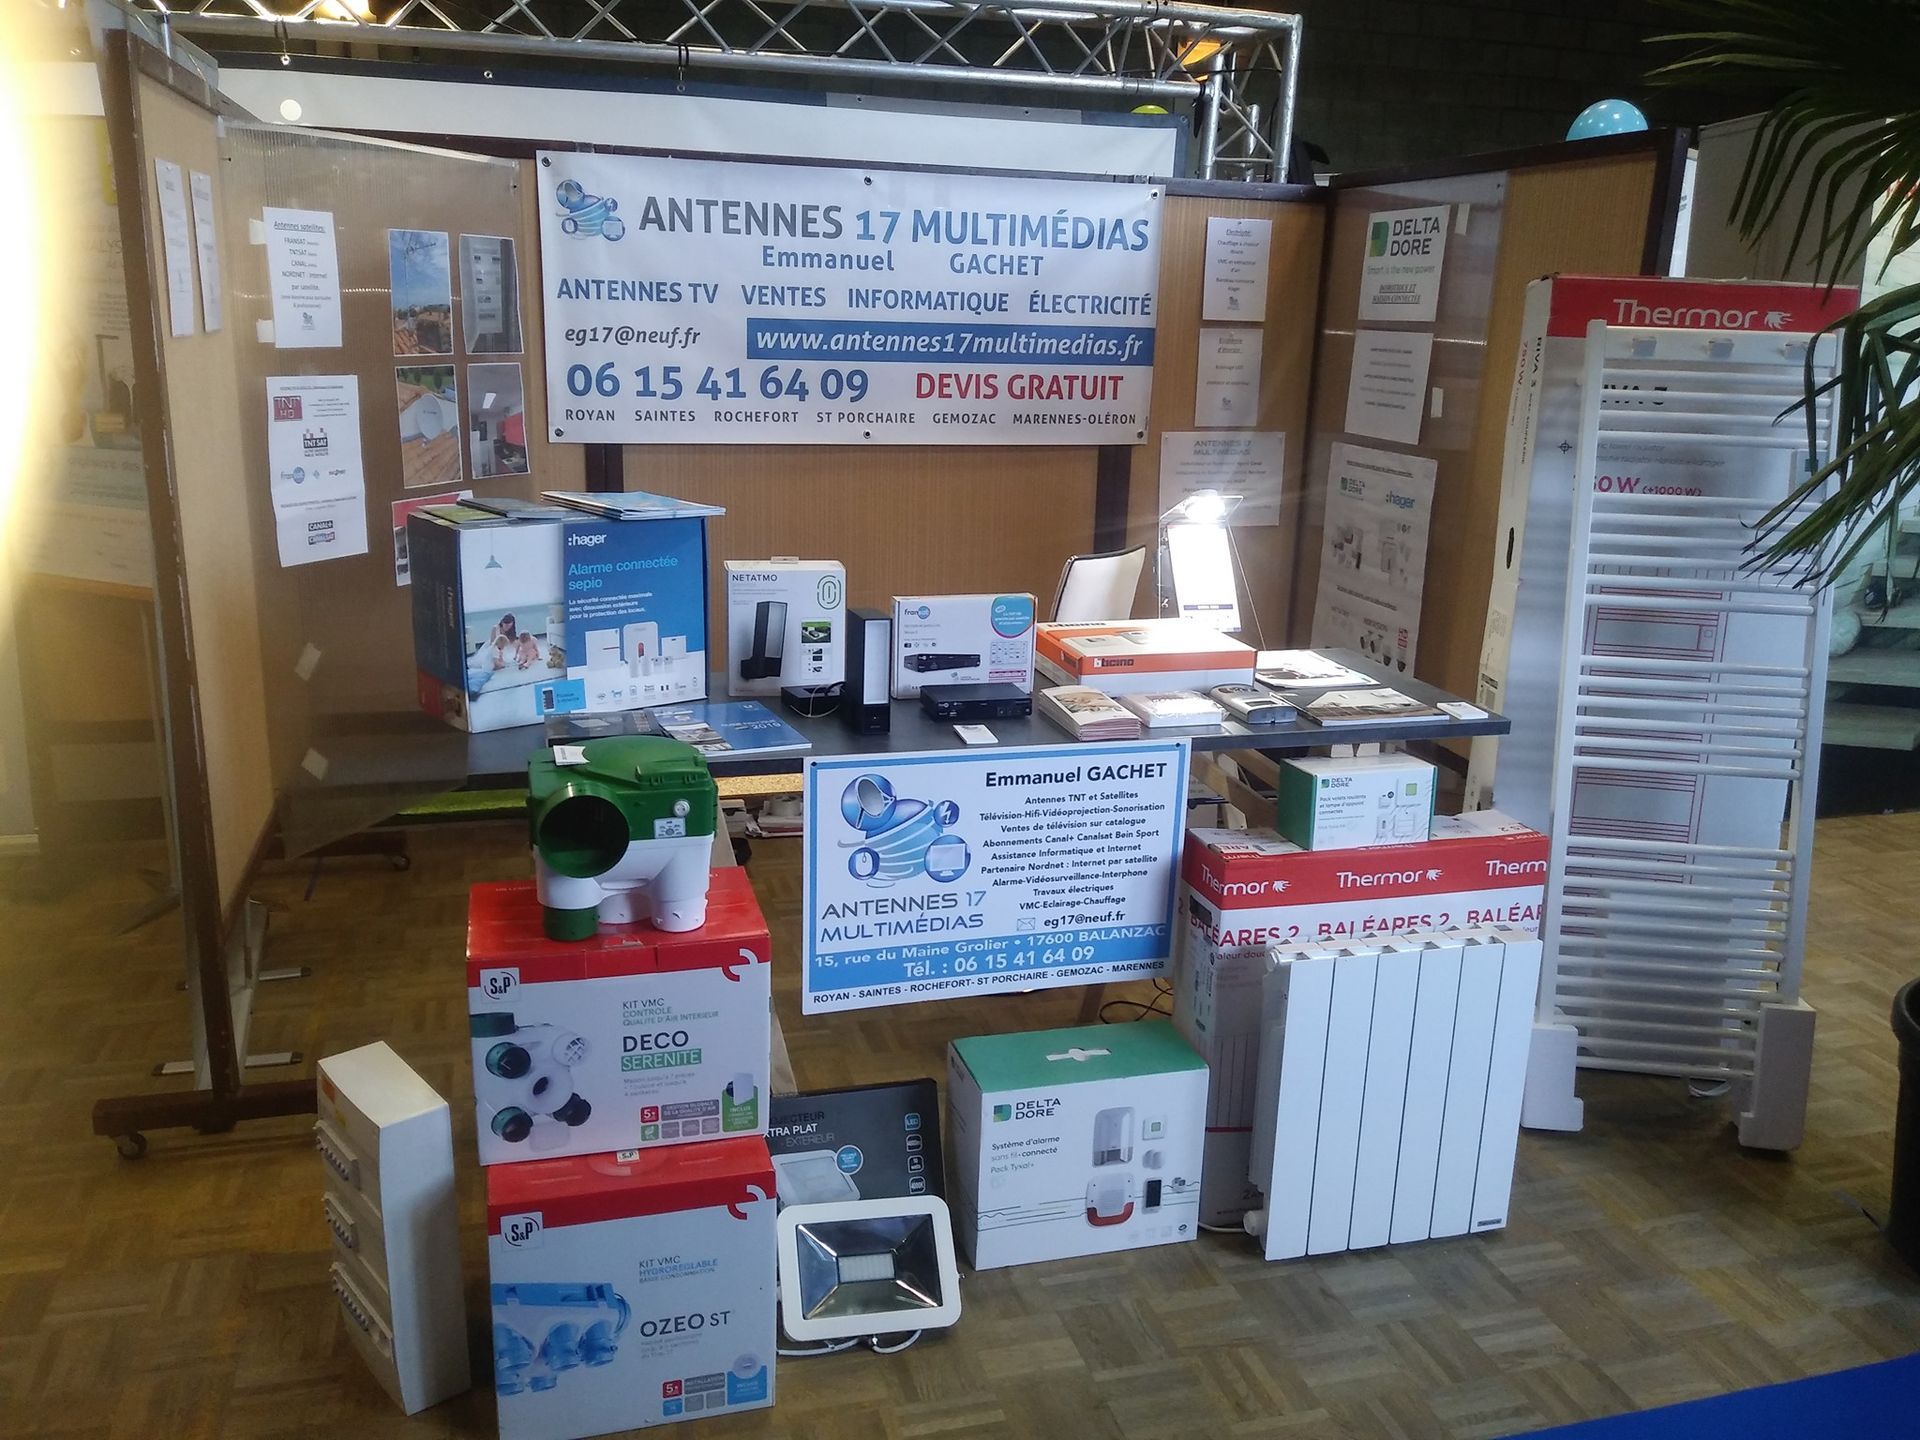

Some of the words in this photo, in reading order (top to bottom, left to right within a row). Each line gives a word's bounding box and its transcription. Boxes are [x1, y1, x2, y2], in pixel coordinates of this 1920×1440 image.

[639, 196, 843, 239] ANTENNES
[856, 209, 901, 244] 17
[911, 208, 1150, 251] MULTIMÉDIAS
[1392, 217, 1440, 236] DELTA
[1390, 238, 1432, 256] DORE
[762, 245, 895, 271] Emmanuel
[950, 252, 1044, 276] GACHET
[557, 278, 682, 303] ANTENNES
[688, 283, 719, 303] TV
[741, 284, 827, 307] VENTES
[848, 288, 1010, 316] INFORMATIQUE
[1029, 289, 1152, 315] ÉLECTRICITÉ
[1613, 299, 1757, 328] Thermor
[564, 326, 701, 348] eg17@neuf.fr
[757, 331, 1143, 361] www.antennes17multimedias.fr
[566, 361, 621, 398] 06
[634, 365, 683, 401] 15
[696, 366, 746, 401] 41
[759, 365, 809, 402] 64
[820, 368, 868, 403] 09
[916, 372, 998, 399] DEVIS
[1007, 374, 1123, 400] GRATUIT
[565, 409, 615, 422] ROYAN
[634, 410, 696, 422] SAINTES
[714, 411, 799, 423] ROCHEFORT
[816, 411, 832, 423] ST
[837, 412, 916, 424] PORCHAIRE
[932, 412, 996, 425] GEMOZAC
[1012, 412, 1136, 426] MARENNES-OLÉRON
[568, 563, 613, 576] Alarme
[616, 556, 679, 572] connectée
[568, 578, 602, 591] sepio
[732, 574, 778, 582] NETATMO
[985, 767, 1081, 787] Emmanuel
[1087, 763, 1167, 782] GACHET
[1024, 795, 1065, 805] Antennes
[1068, 794, 1086, 802] TNT
[1088, 793, 1098, 801] et
[1099, 791, 1139, 801] Satellites
[979, 803, 1165, 821] Télévision-Hifi-Vidéoprojection-Sonorisation
[1000, 824, 1030, 833] Ventes
[1032, 823, 1044, 831] de
[1046, 820, 1087, 830] télévision
[1105, 817, 1146, 828] catalogue
[983, 838, 1043, 848] Abonnements
[1045, 835, 1075, 844] Canal+
[1077, 832, 1113, 841] Canalsat
[1115, 830, 1133, 839] Bein
[1135, 829, 1160, 840] Sport
[991, 851, 1036, 860] Assistance
[1038, 846, 1094, 858] Informatique
[1107, 843, 1142, 852] Internet
[981, 865, 1026, 874] Partenaire
[1028, 861, 1064, 871] Nordnet
[1071, 858, 1106, 867] Internet
[1108, 858, 1123, 866] par
[1124, 855, 1158, 864] satellite
[1486, 860, 1547, 876] Therm
[992, 869, 1148, 887] Alarme-Vidéosurveillance-Interphone
[1202, 864, 1270, 896] Thermor
[1336, 871, 1424, 889] Thermor
[1033, 887, 1065, 896] Travaux
[1068, 883, 1114, 895] électriques
[821, 893, 958, 920] ANTENNES
[965, 891, 987, 907] 17
[1019, 895, 1126, 910] VMC-Eclairage-Chauffage
[820, 912, 984, 942] MULTIMÉDIAS
[1043, 911, 1126, 929] eg17@neuf.fr
[815, 955, 839, 968] 15,
[844, 953, 871, 965] rue
[876, 950, 896, 961] du
[902, 946, 950, 958] Maine
[955, 939, 1009, 954] Grolier
[1027, 933, 1074, 946] 17600
[1078, 925, 1166, 942] BALANZAC
[903, 962, 936, 978] Tél.
[954, 957, 978, 973] 06
[985, 953, 1008, 969] 15
[1012, 950, 1035, 966] 41
[1042, 947, 1065, 964] 64
[1071, 945, 1095, 961] 09
[490, 976, 511, 994] S&P
[813, 992, 850, 1004] ROYAN
[858, 986, 901, 998] SAINTES
[977, 977, 989, 987] ST
[991, 972, 1048, 984] PORCHAIRE
[1056, 966, 1104, 978] GEMOZAC
[1111, 961, 1165, 973] MARENNES
[622, 1000, 639, 1010] KIT
[641, 998, 665, 1008] VMC
[622, 1007, 673, 1018] CONTROLE
[623, 1030, 689, 1053] DECO
[622, 1050, 700, 1071] SERENITE
[1015, 1098, 1061, 1110] DELTA
[1015, 1108, 1055, 1120] DORE
[793, 1123, 818, 1135] PLAT
[992, 1140, 1024, 1151] Système
[1026, 1136, 1060, 1146] d'alarme
[1021, 1147, 1058, 1158] connecté
[511, 1221, 533, 1241] S&P
[639, 1259, 655, 1268] KIT
[658, 1255, 681, 1266] VMC
[640, 1313, 705, 1337] OZEO
[710, 1310, 731, 1327] ST
